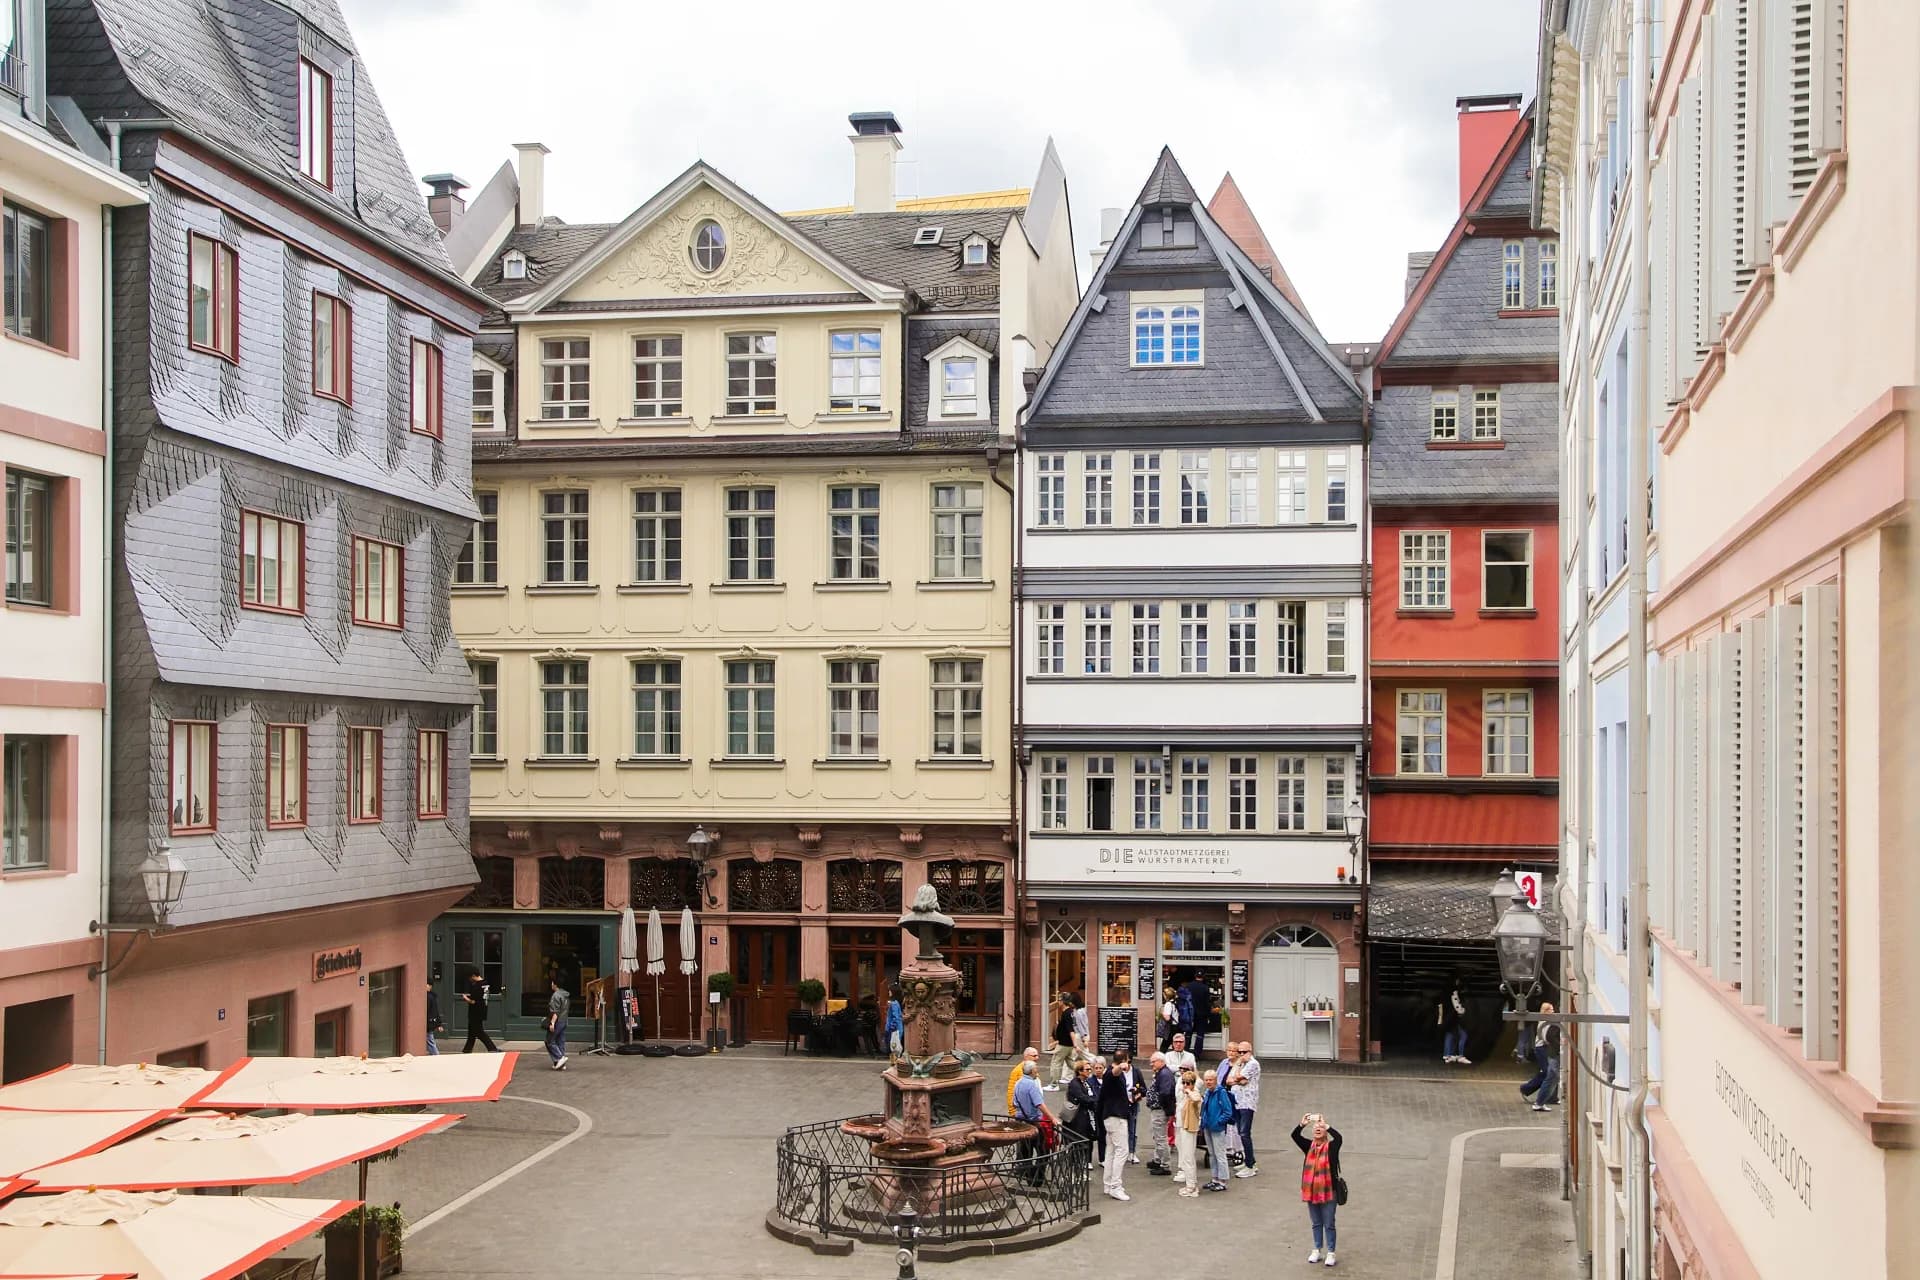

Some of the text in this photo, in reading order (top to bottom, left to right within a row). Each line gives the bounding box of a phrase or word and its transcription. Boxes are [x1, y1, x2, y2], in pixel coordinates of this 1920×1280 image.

[1099, 848, 1230, 863] DIE ALTSTADTMETZGEREI
[317, 948, 362, 978] Friedrich
[1715, 1059, 1770, 1158] HOPPENWORTH
[1770, 1124, 1778, 1166] &
[1779, 1131, 1812, 1211] PLOCH
